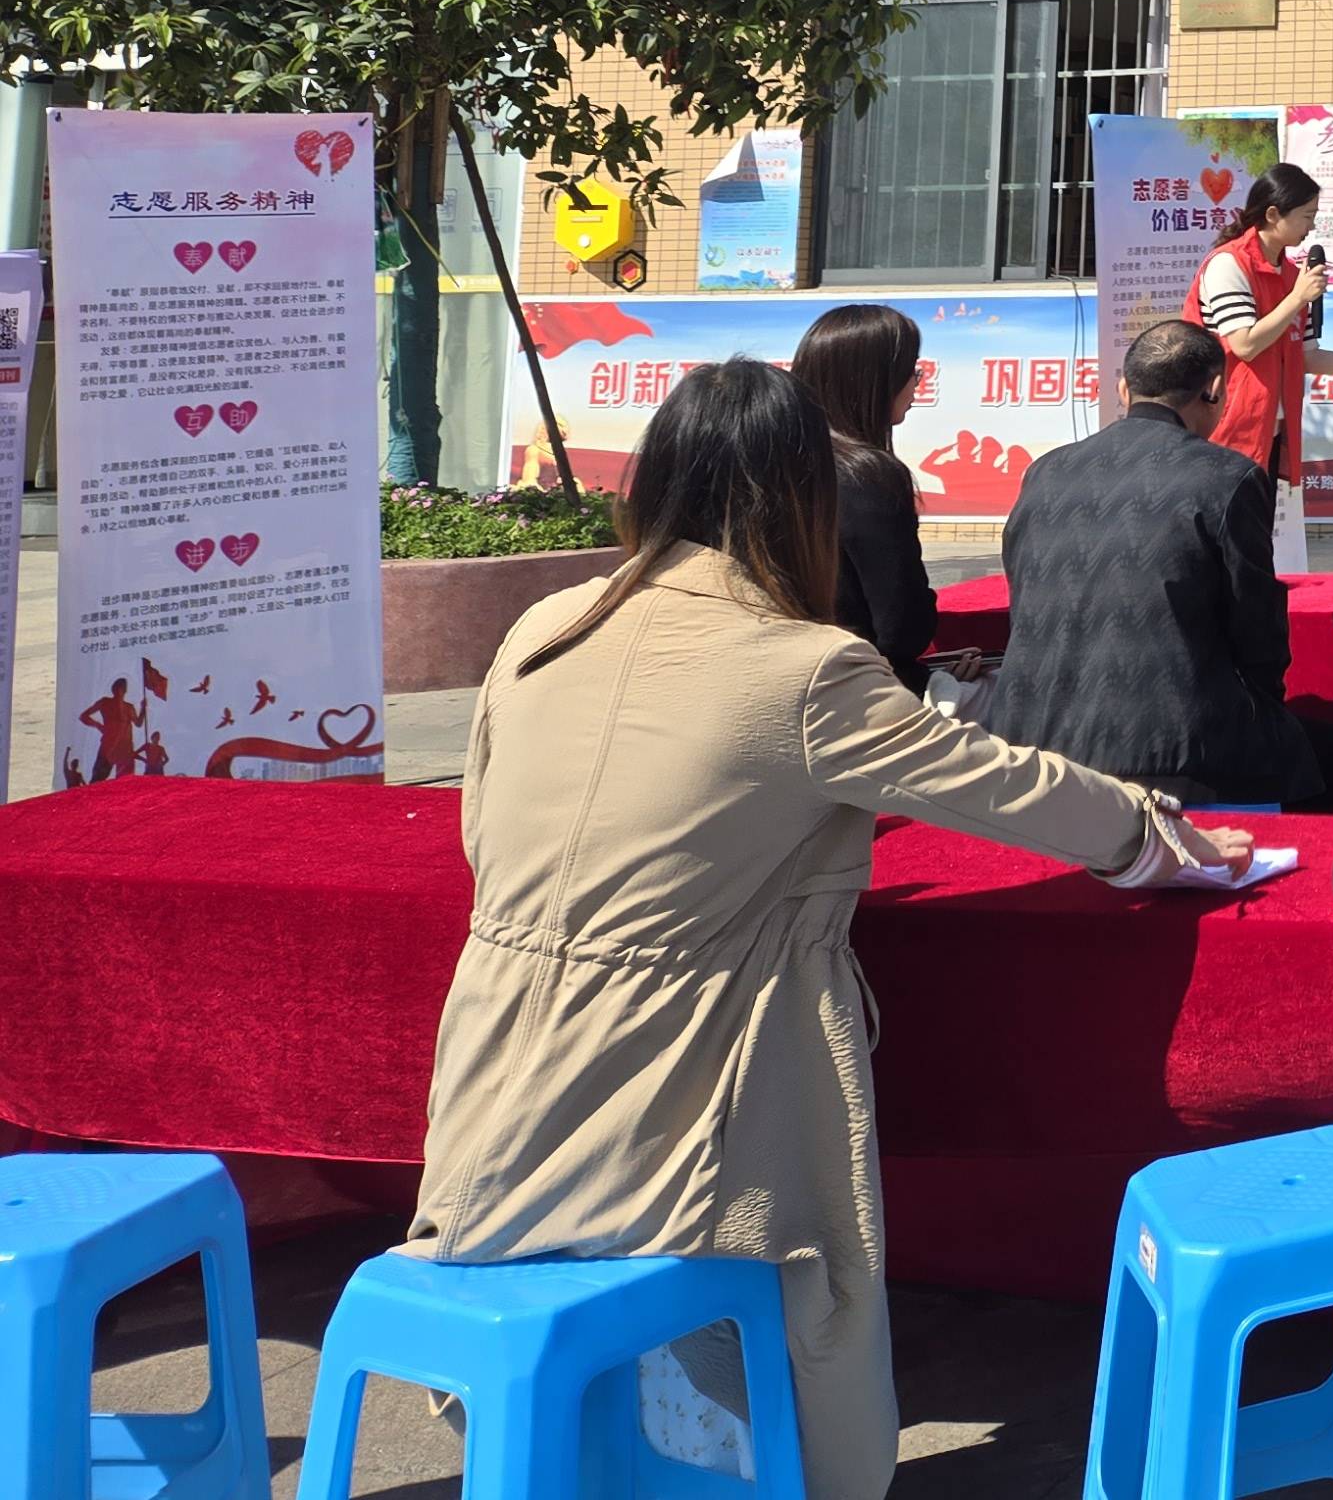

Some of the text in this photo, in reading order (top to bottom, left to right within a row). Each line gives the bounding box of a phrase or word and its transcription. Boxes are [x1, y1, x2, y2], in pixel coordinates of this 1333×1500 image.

[109, 190, 315, 212] 志愿服务精神
[1133, 178, 1190, 201] 志愿者
[588, 361, 697, 407] 创新
